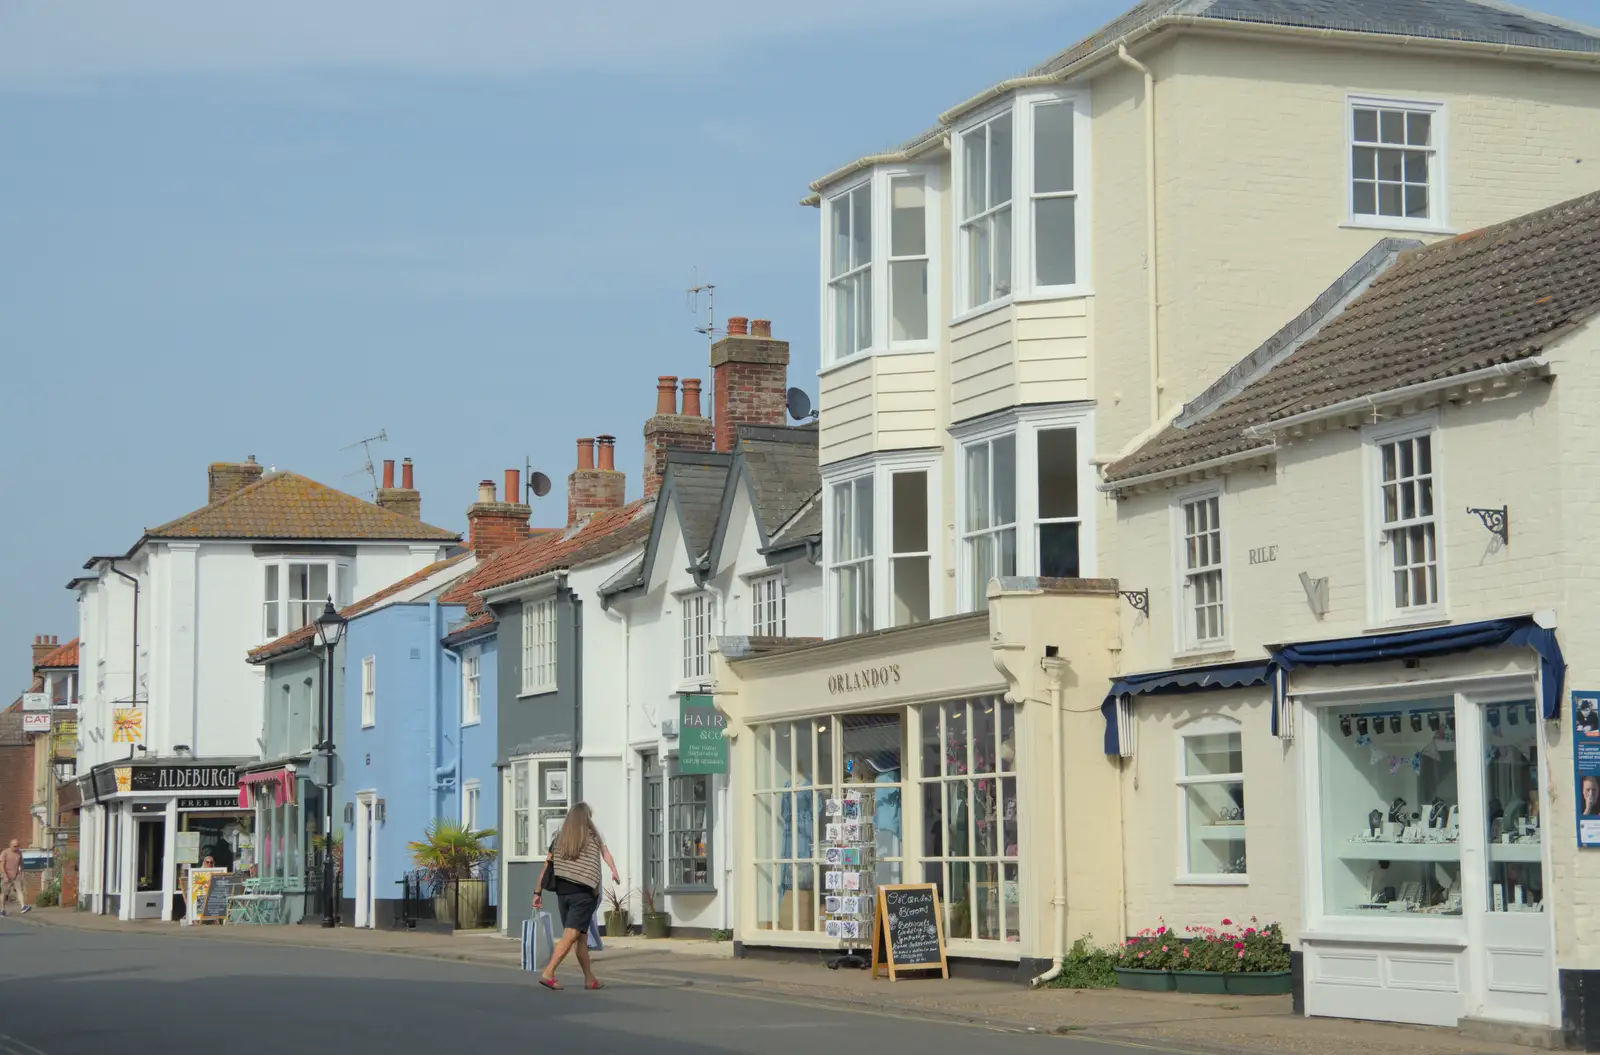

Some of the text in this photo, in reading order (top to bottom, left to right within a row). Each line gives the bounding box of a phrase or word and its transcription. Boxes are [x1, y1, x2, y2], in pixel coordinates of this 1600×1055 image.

[828, 664, 900, 694] ORLANDO'S
[25, 715, 48, 724] CAT
[684, 714, 723, 726] HAIR
[158, 768, 236, 787] ALDEBURGH
[181, 799, 210, 807] FREE
